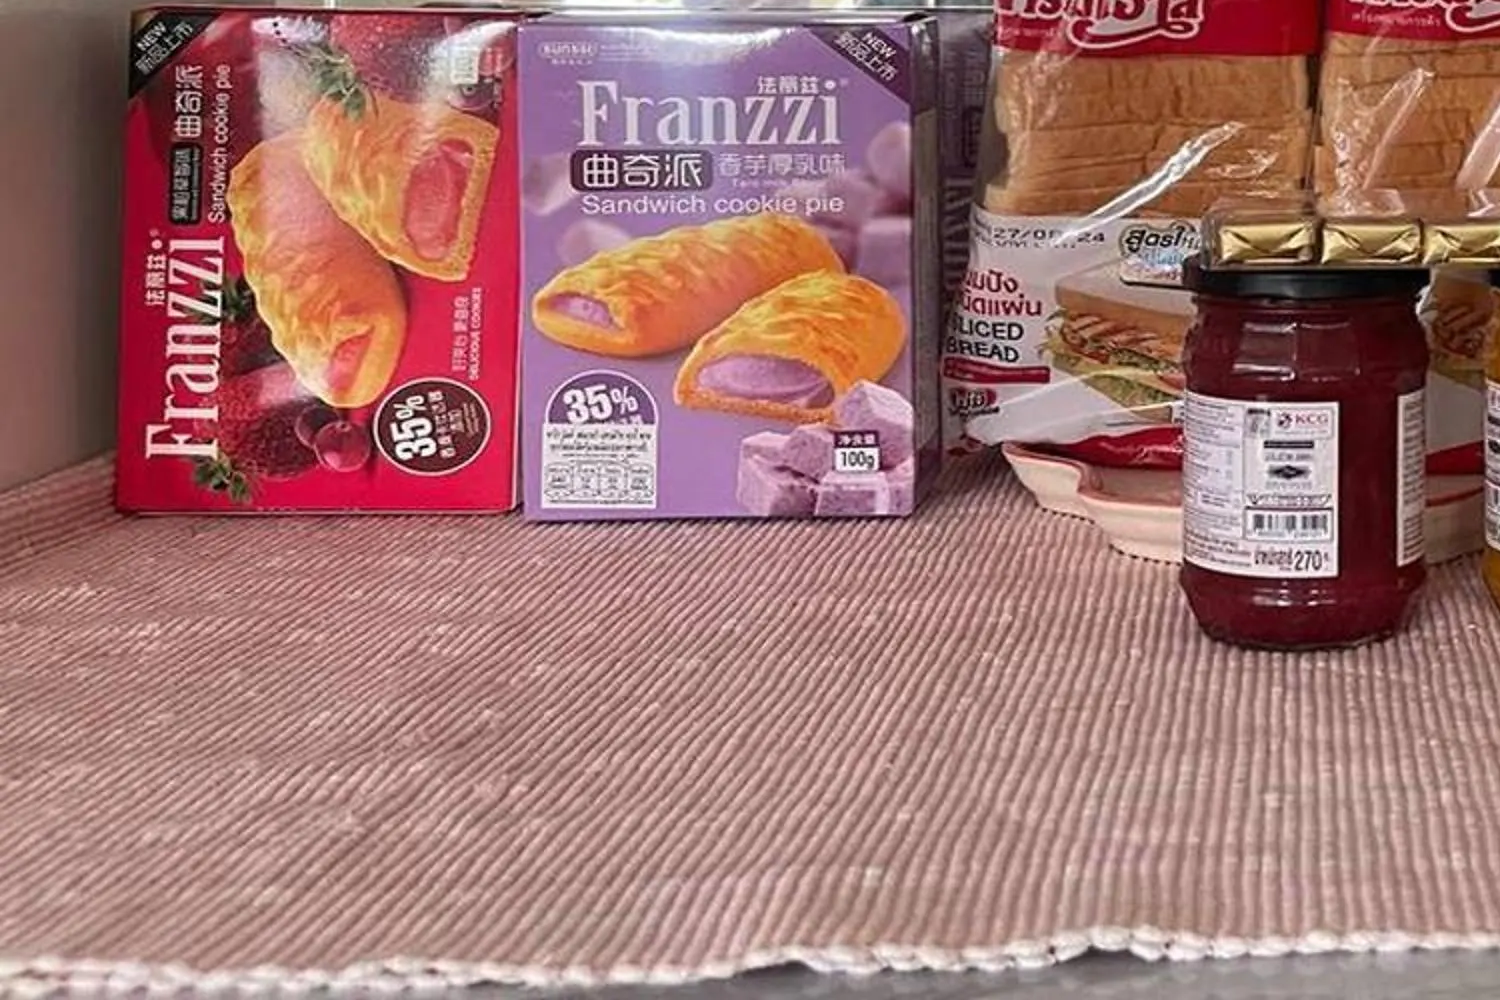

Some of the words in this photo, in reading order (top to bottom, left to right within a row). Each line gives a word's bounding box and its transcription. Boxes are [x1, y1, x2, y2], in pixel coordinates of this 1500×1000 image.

[137, 20, 167, 51] NEW
[862, 31, 896, 58] NEW
[216, 64, 232, 89] pie
[174, 65, 203, 138] 曲奇派
[576, 79, 842, 146] Franzzi
[212, 92, 229, 145] cookie
[583, 153, 703, 188] 曲奇派
[719, 152, 845, 177] 香芋厚乳味
[207, 147, 226, 223] Sandwich
[581, 194, 706, 215] Sandwich
[713, 195, 798, 214] cookie
[804, 195, 845, 217] pie
[961, 288, 1042, 317] นิดแผ่น
[145, 236, 225, 460] Franzzi
[946, 335, 1020, 363] BREAD
[563, 384, 639, 423] 35%
[389, 395, 438, 460] 35%
[1295, 413, 1328, 427] KCG
[840, 450, 875, 470] 100g
[1294, 549, 1322, 571] 270
